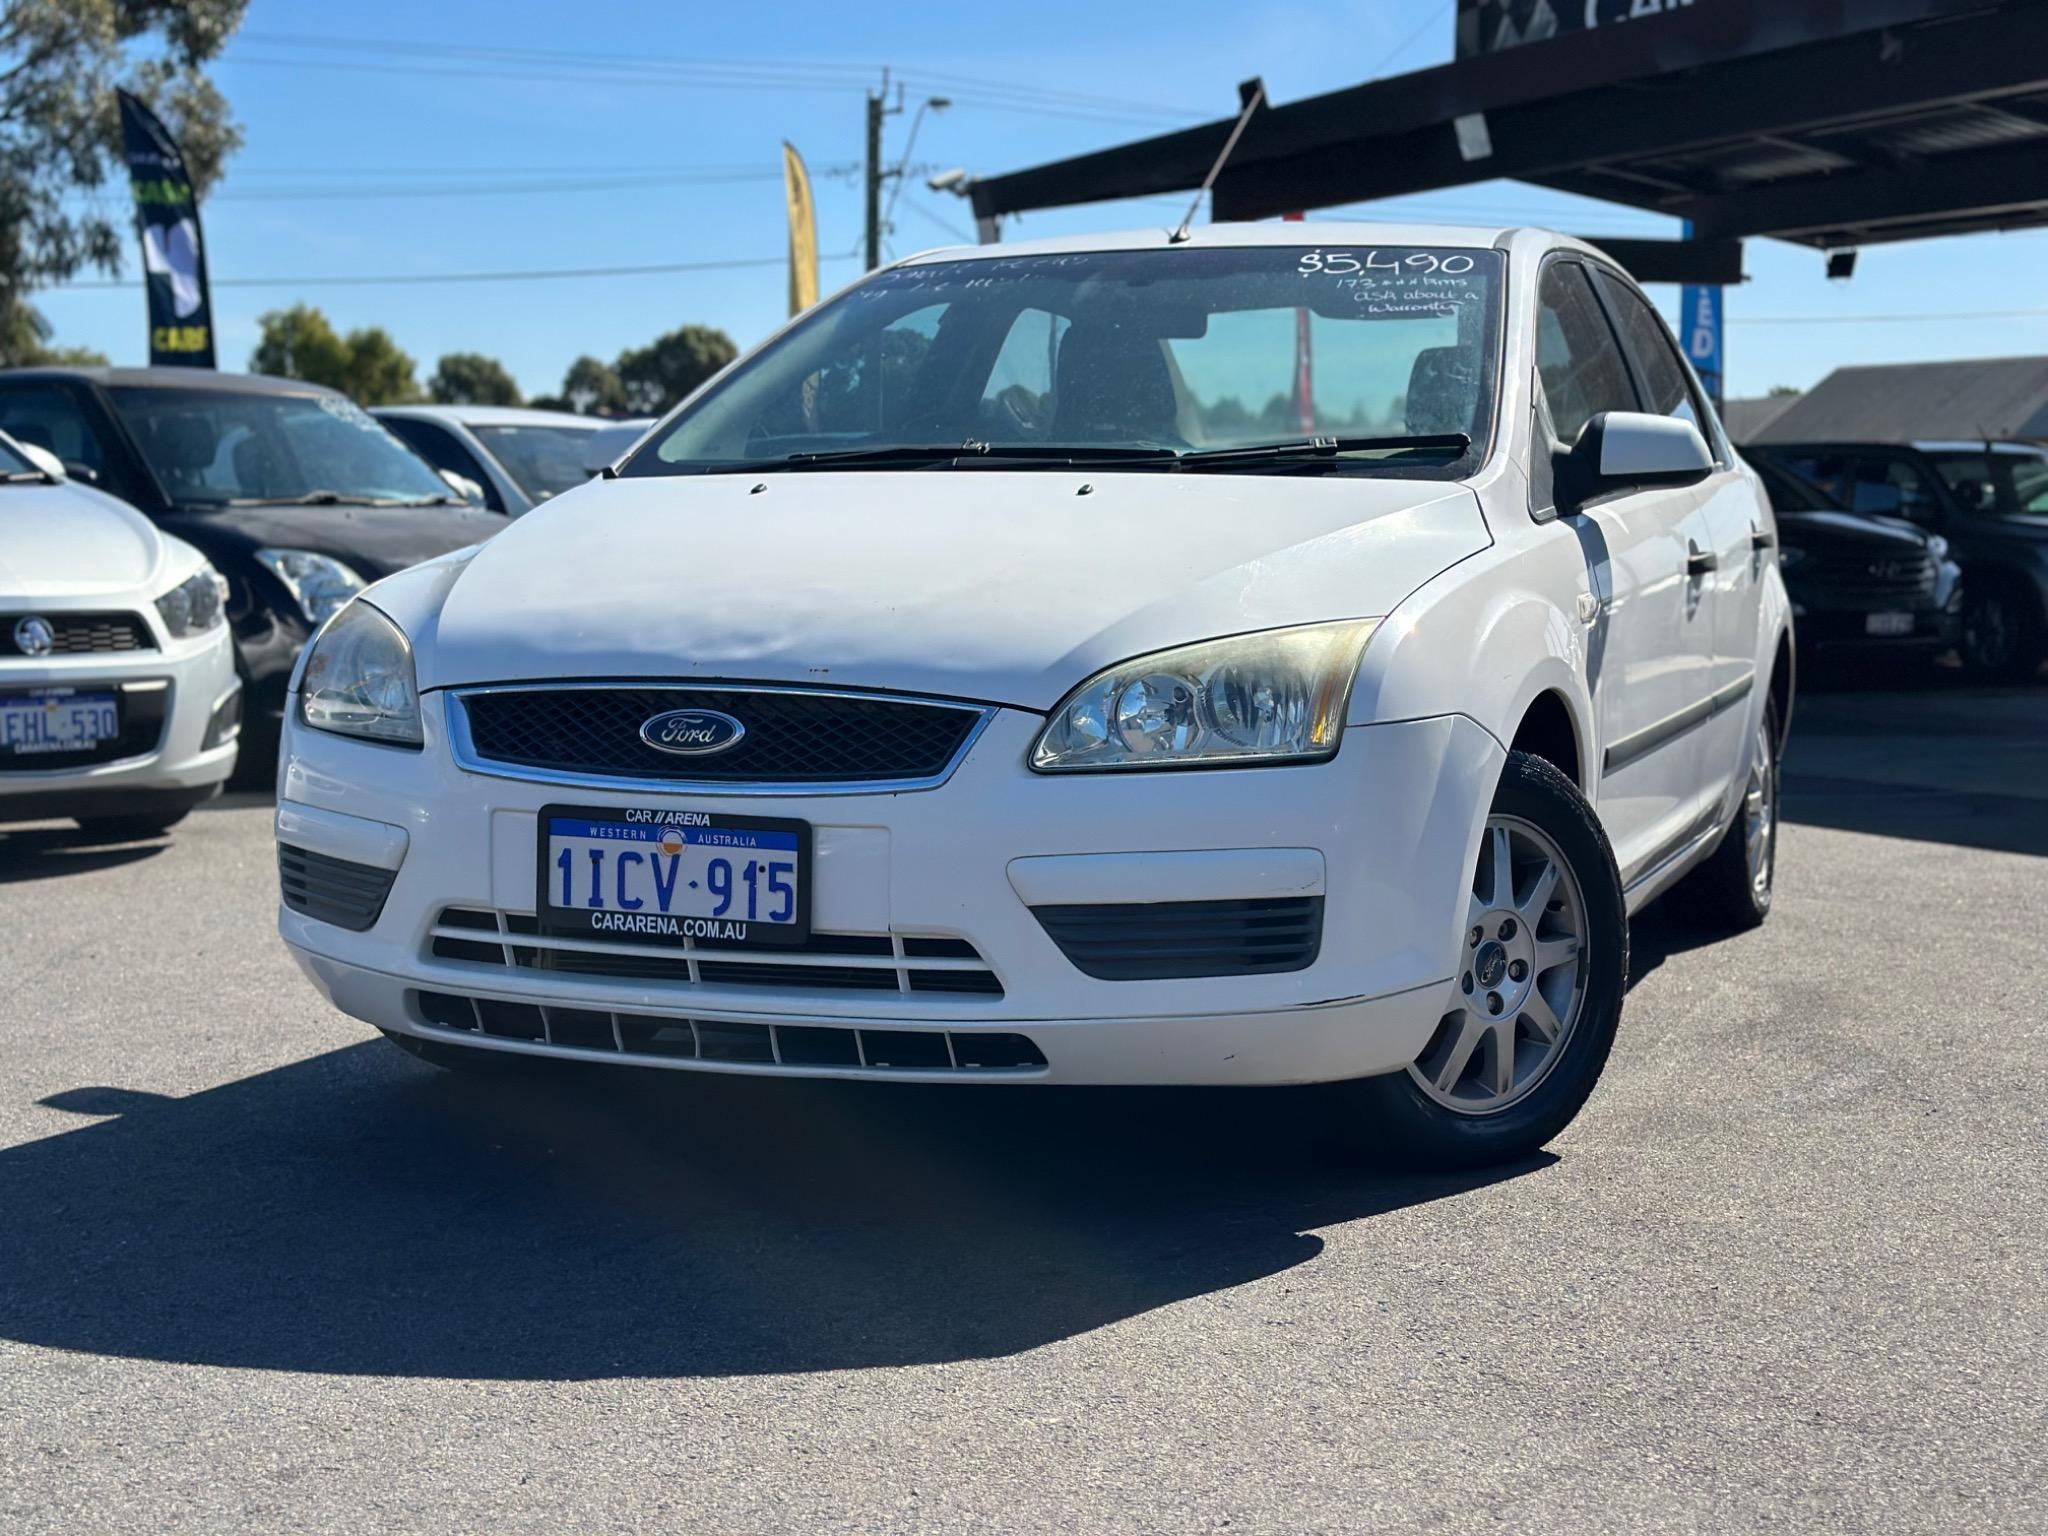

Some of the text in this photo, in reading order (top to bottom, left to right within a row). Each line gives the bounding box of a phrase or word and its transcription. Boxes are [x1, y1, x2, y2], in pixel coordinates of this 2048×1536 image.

[1298, 250, 1475, 277] $5,490
[1403, 289, 1455, 300] about
[661, 717, 717, 743] Ford
[589, 826, 757, 847] WESTERN AUSTRALIA
[591, 912, 747, 940] CARARENA.COM.AU
